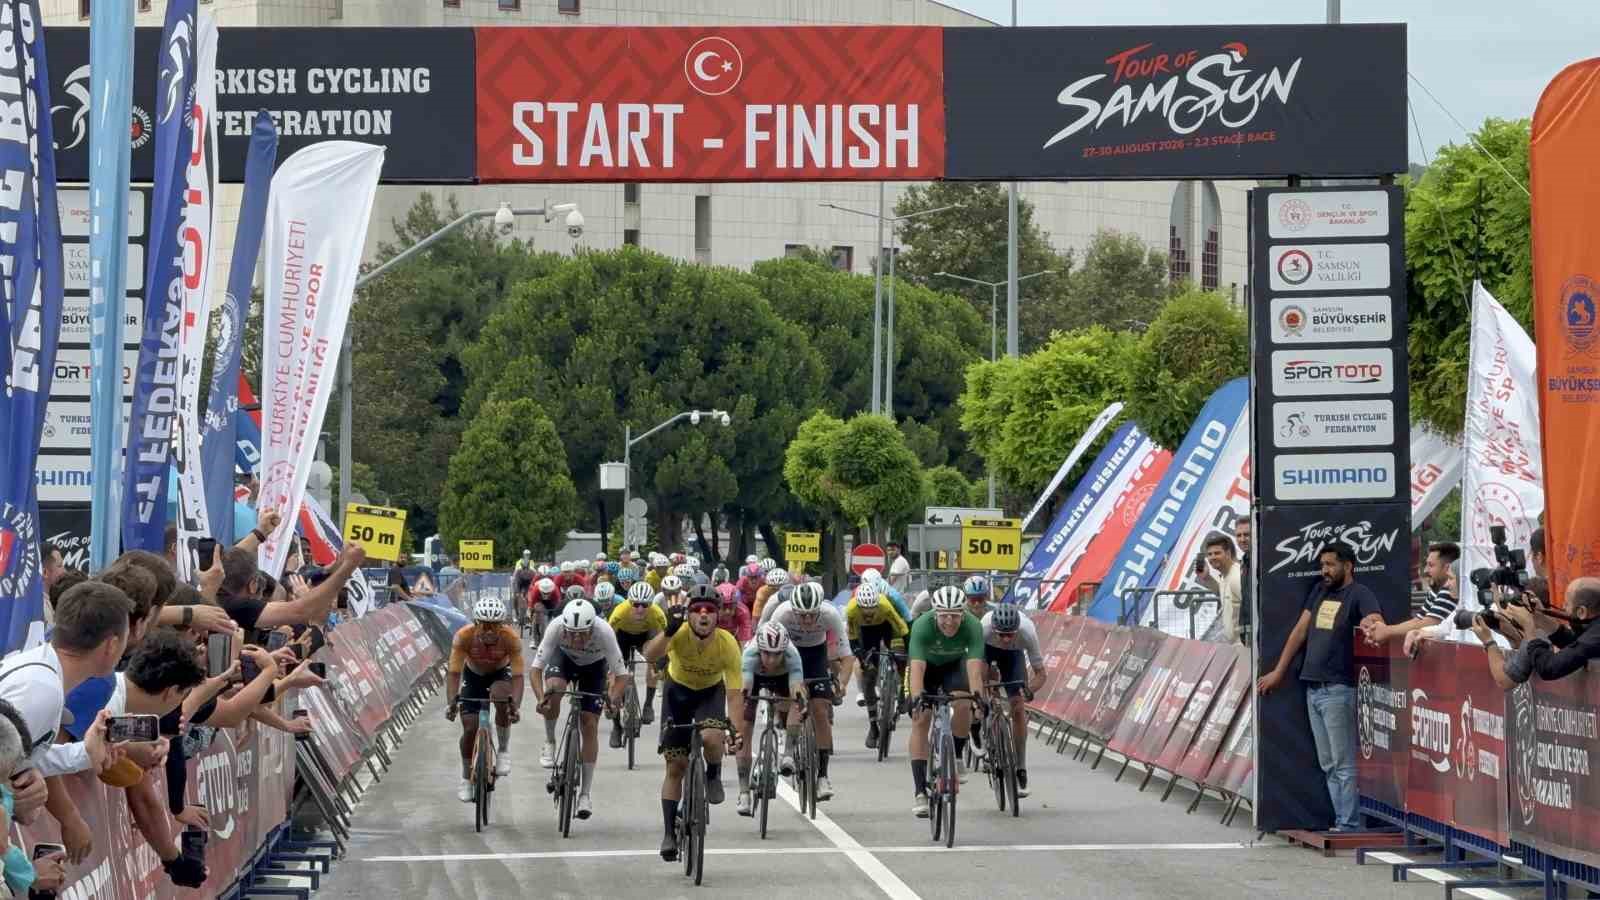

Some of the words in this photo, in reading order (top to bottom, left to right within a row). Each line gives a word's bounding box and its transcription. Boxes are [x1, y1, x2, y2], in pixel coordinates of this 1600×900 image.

[1106, 43, 1171, 83] TOUR
[1174, 51, 1200, 68] OF
[307, 67, 431, 94] CYCLING
[512, 101, 684, 167] START
[745, 103, 919, 168] FINISH
[1113, 141, 1157, 155] AUGUST
[1211, 133, 1243, 147] STAGE
[1247, 131, 1277, 142] RACE
[304, 263, 324, 320] SPOR
[1312, 311, 1387, 326] BÜYÜKŞEHİR
[1283, 364, 1383, 380] SPORTOTO
[1282, 467, 1388, 485] SHIMANO
[1112, 419, 1227, 600] SHIMANO
[350, 524, 374, 542] 50
[378, 532, 395, 545] m
[460, 551, 479, 561] 100
[482, 553, 492, 561] m
[787, 544, 806, 553] 100
[968, 538, 992, 555] 50
[996, 543, 1014, 555] m
